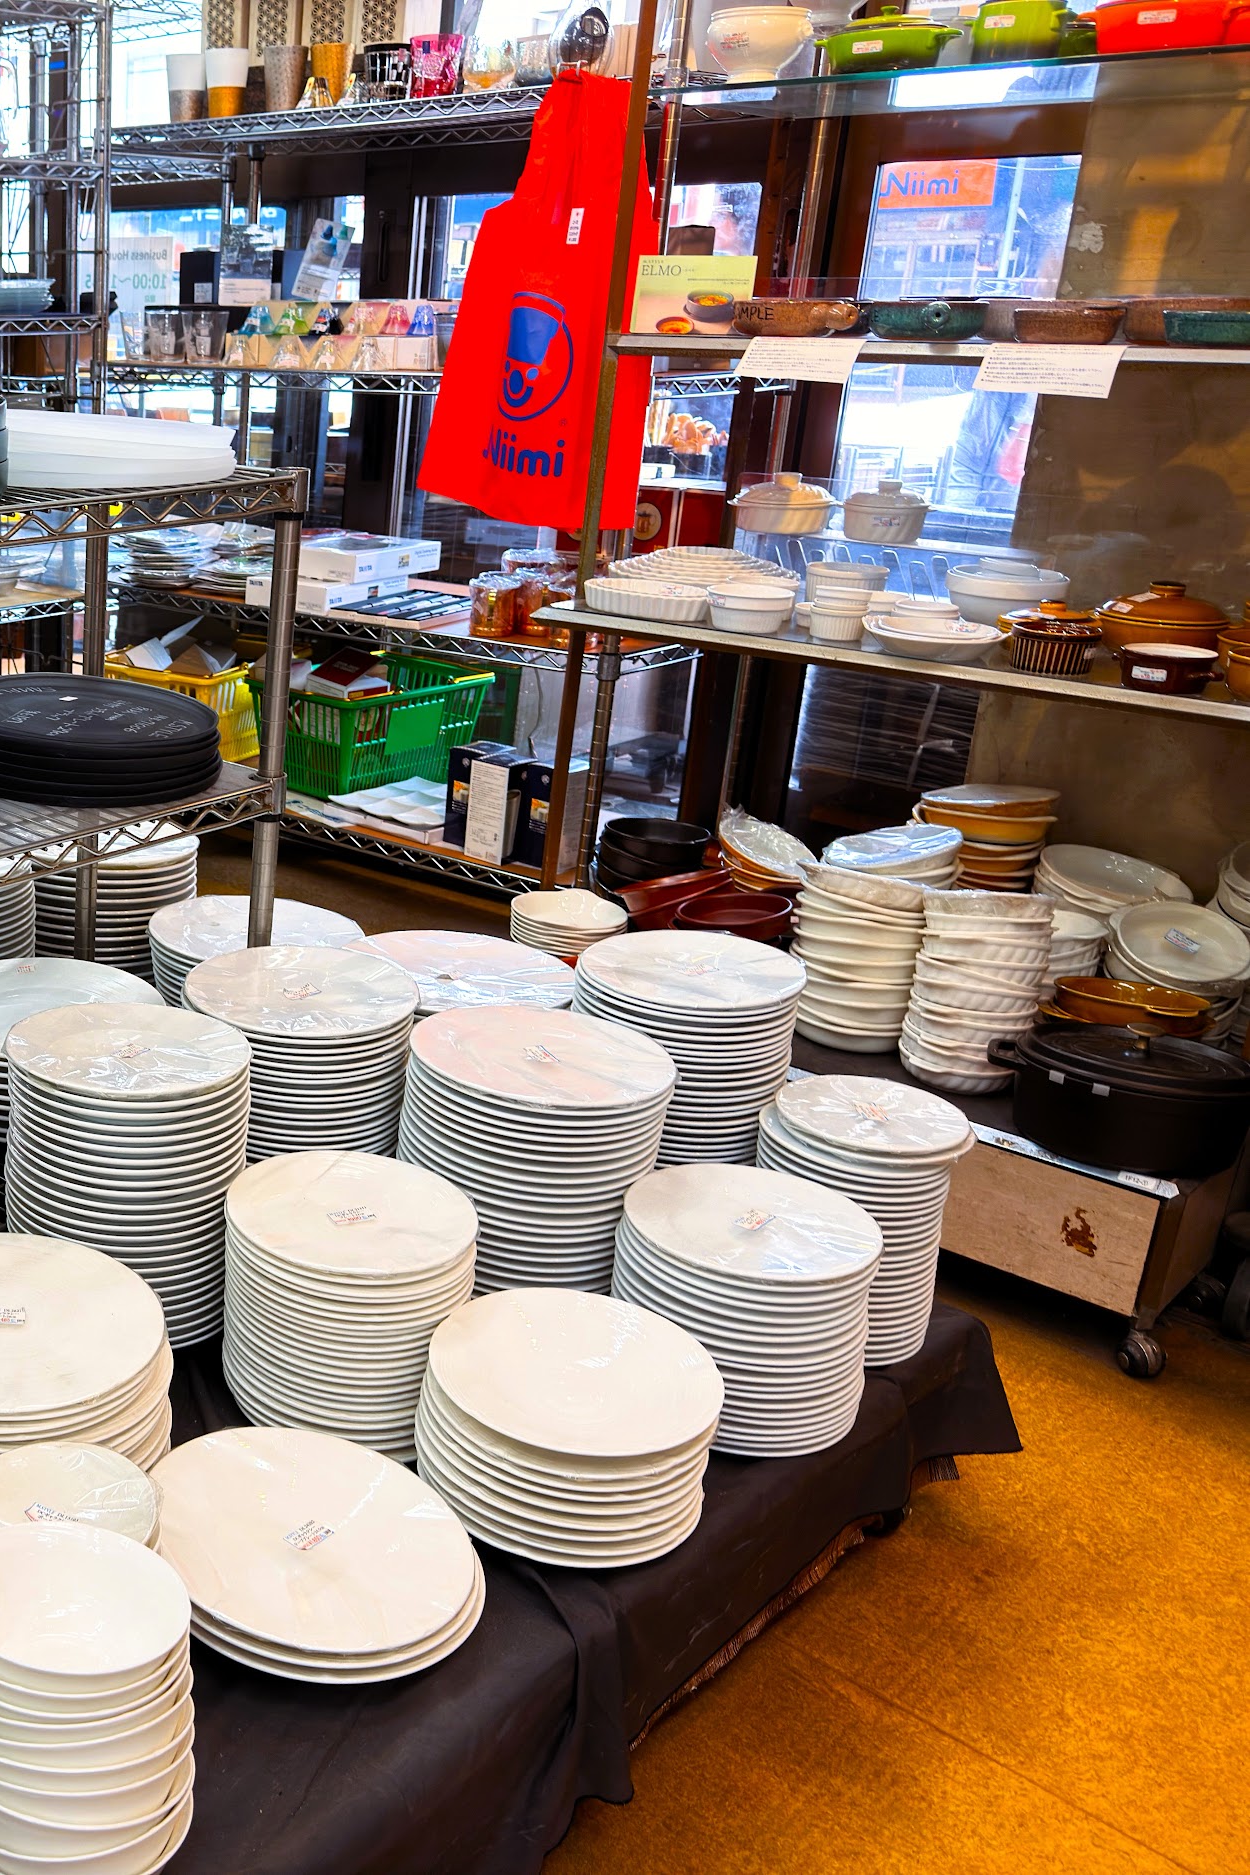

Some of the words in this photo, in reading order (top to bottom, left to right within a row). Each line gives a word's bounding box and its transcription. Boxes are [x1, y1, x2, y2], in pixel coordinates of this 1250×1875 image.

[879, 169, 959, 197] Niimi
[641, 264, 682, 277] ELMO
[737, 305, 774, 321] MPLE
[483, 424, 565, 477] Niimi
